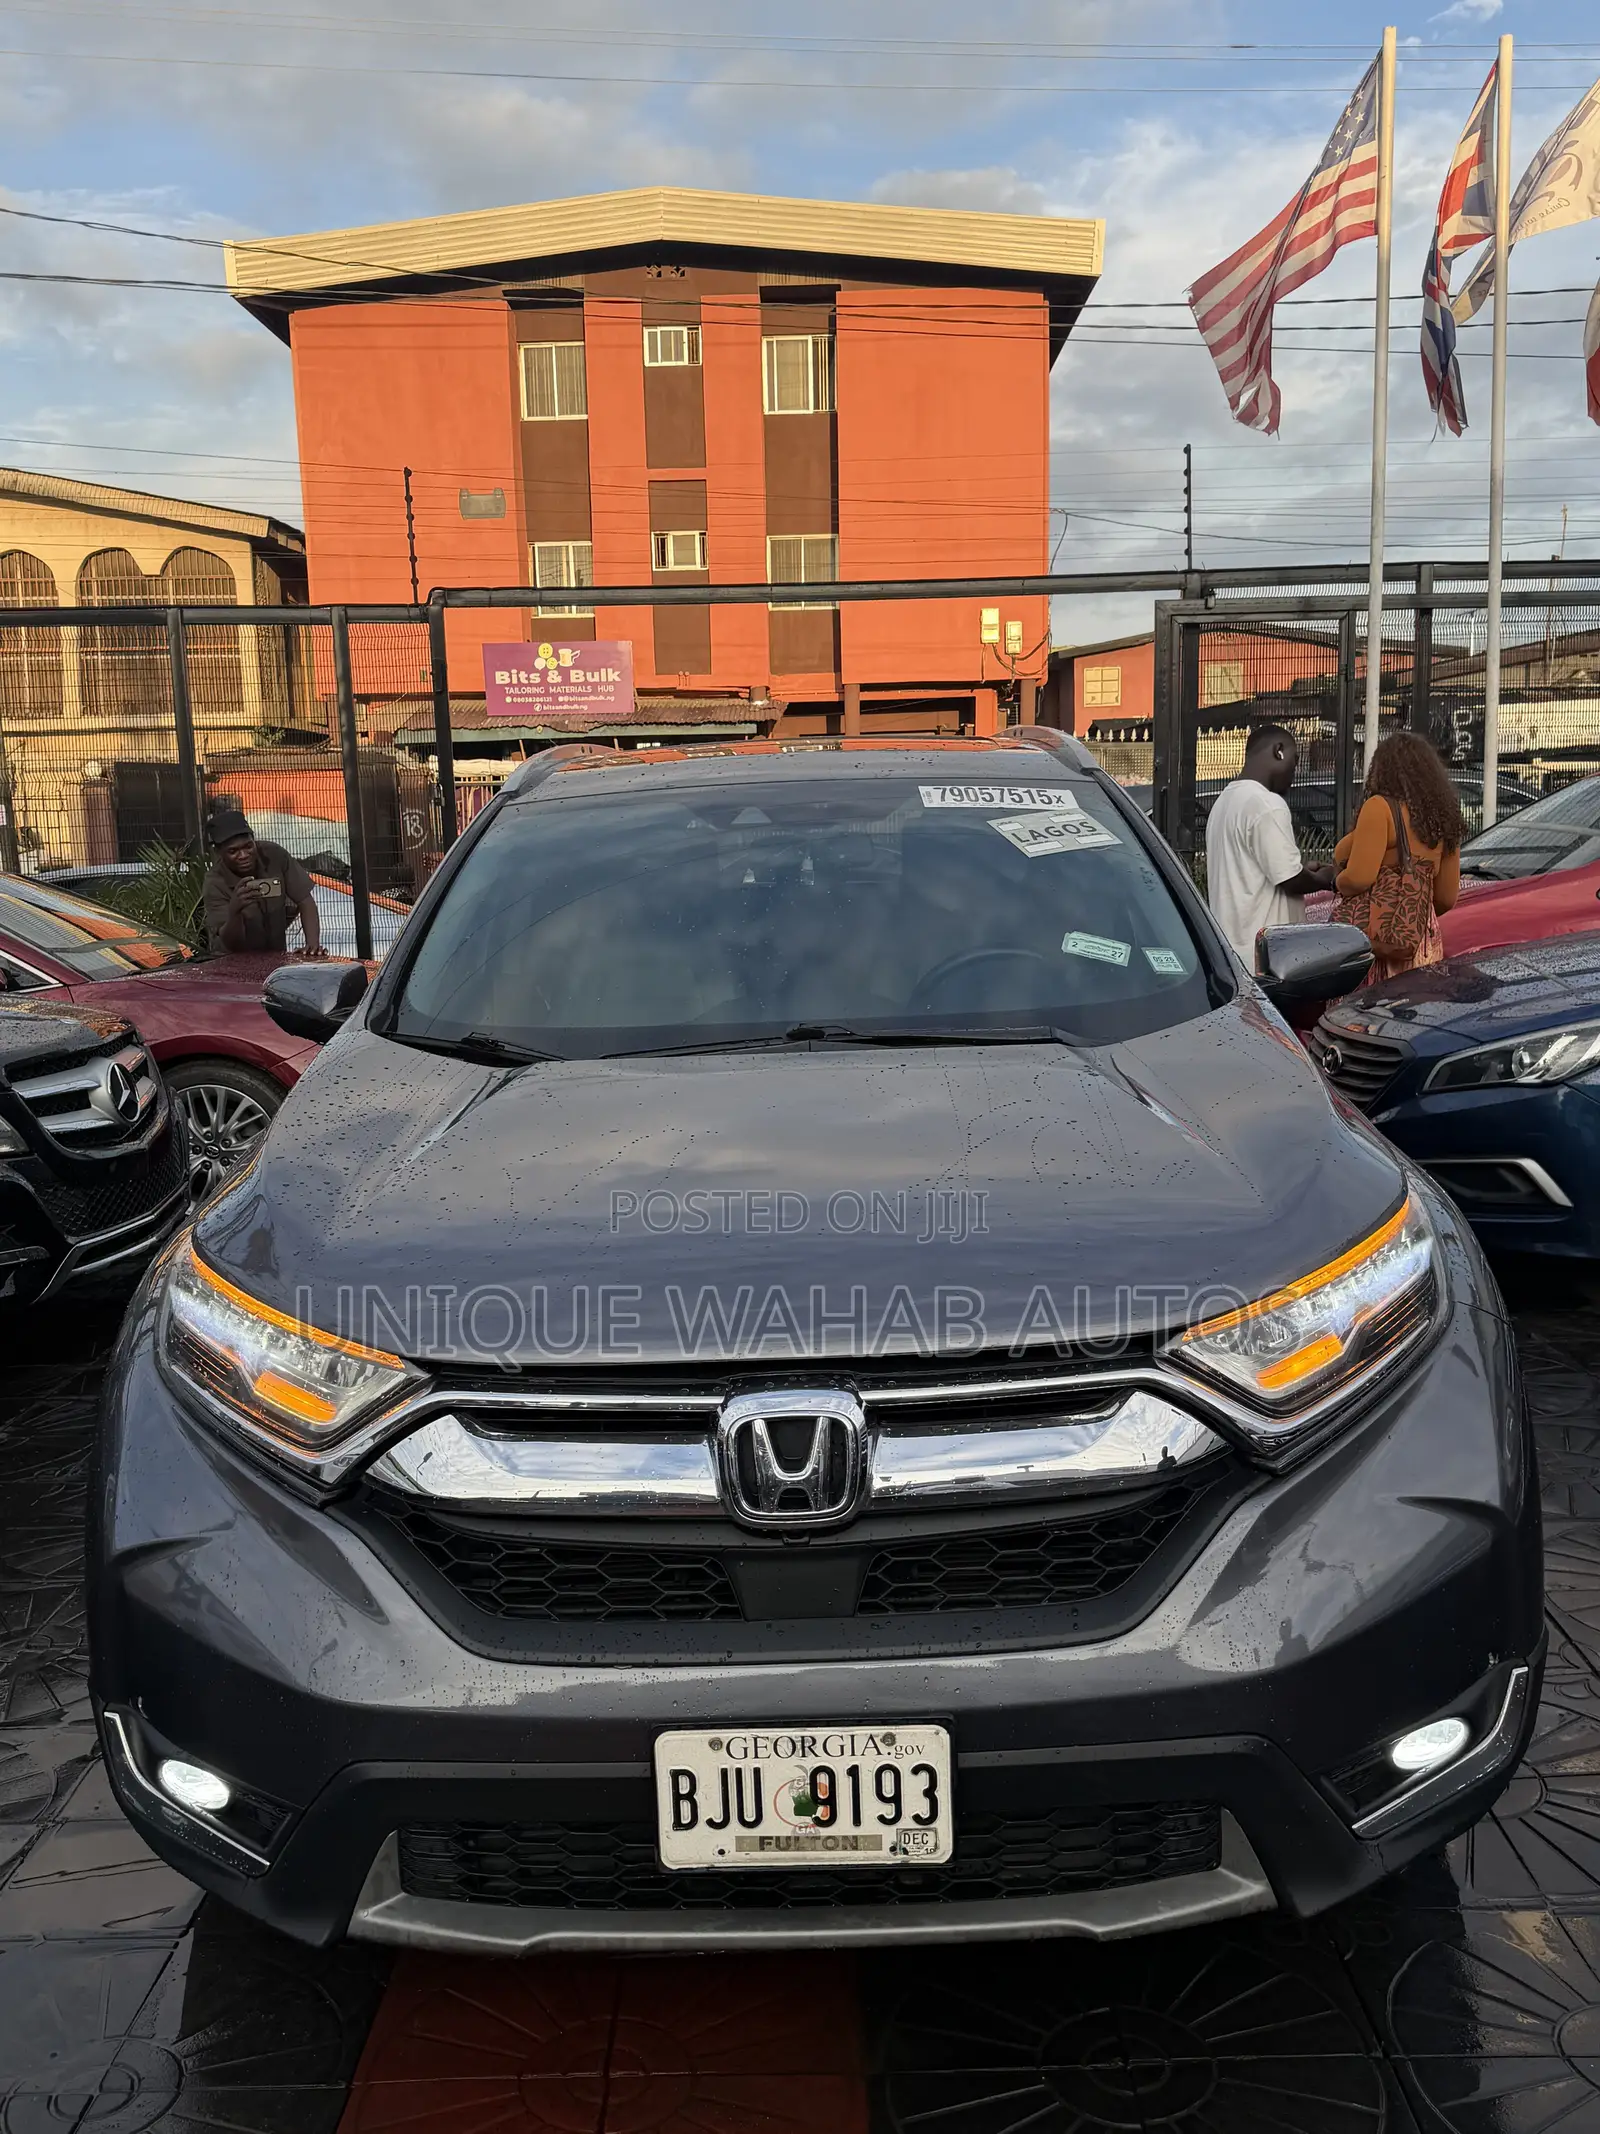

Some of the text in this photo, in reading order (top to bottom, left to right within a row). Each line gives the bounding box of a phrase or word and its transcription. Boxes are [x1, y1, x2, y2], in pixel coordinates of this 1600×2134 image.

[495, 668, 622, 684] Bits & Bulk
[504, 684, 615, 694] TAILORING MATERIALS HUB
[1011, 820, 1097, 844] LAGOS
[1111, 950, 1124, 959] 27
[669, 1763, 941, 1831] BJU 9193
[759, 1835, 859, 1851] FULTON
[903, 1832, 929, 1845] DEC
